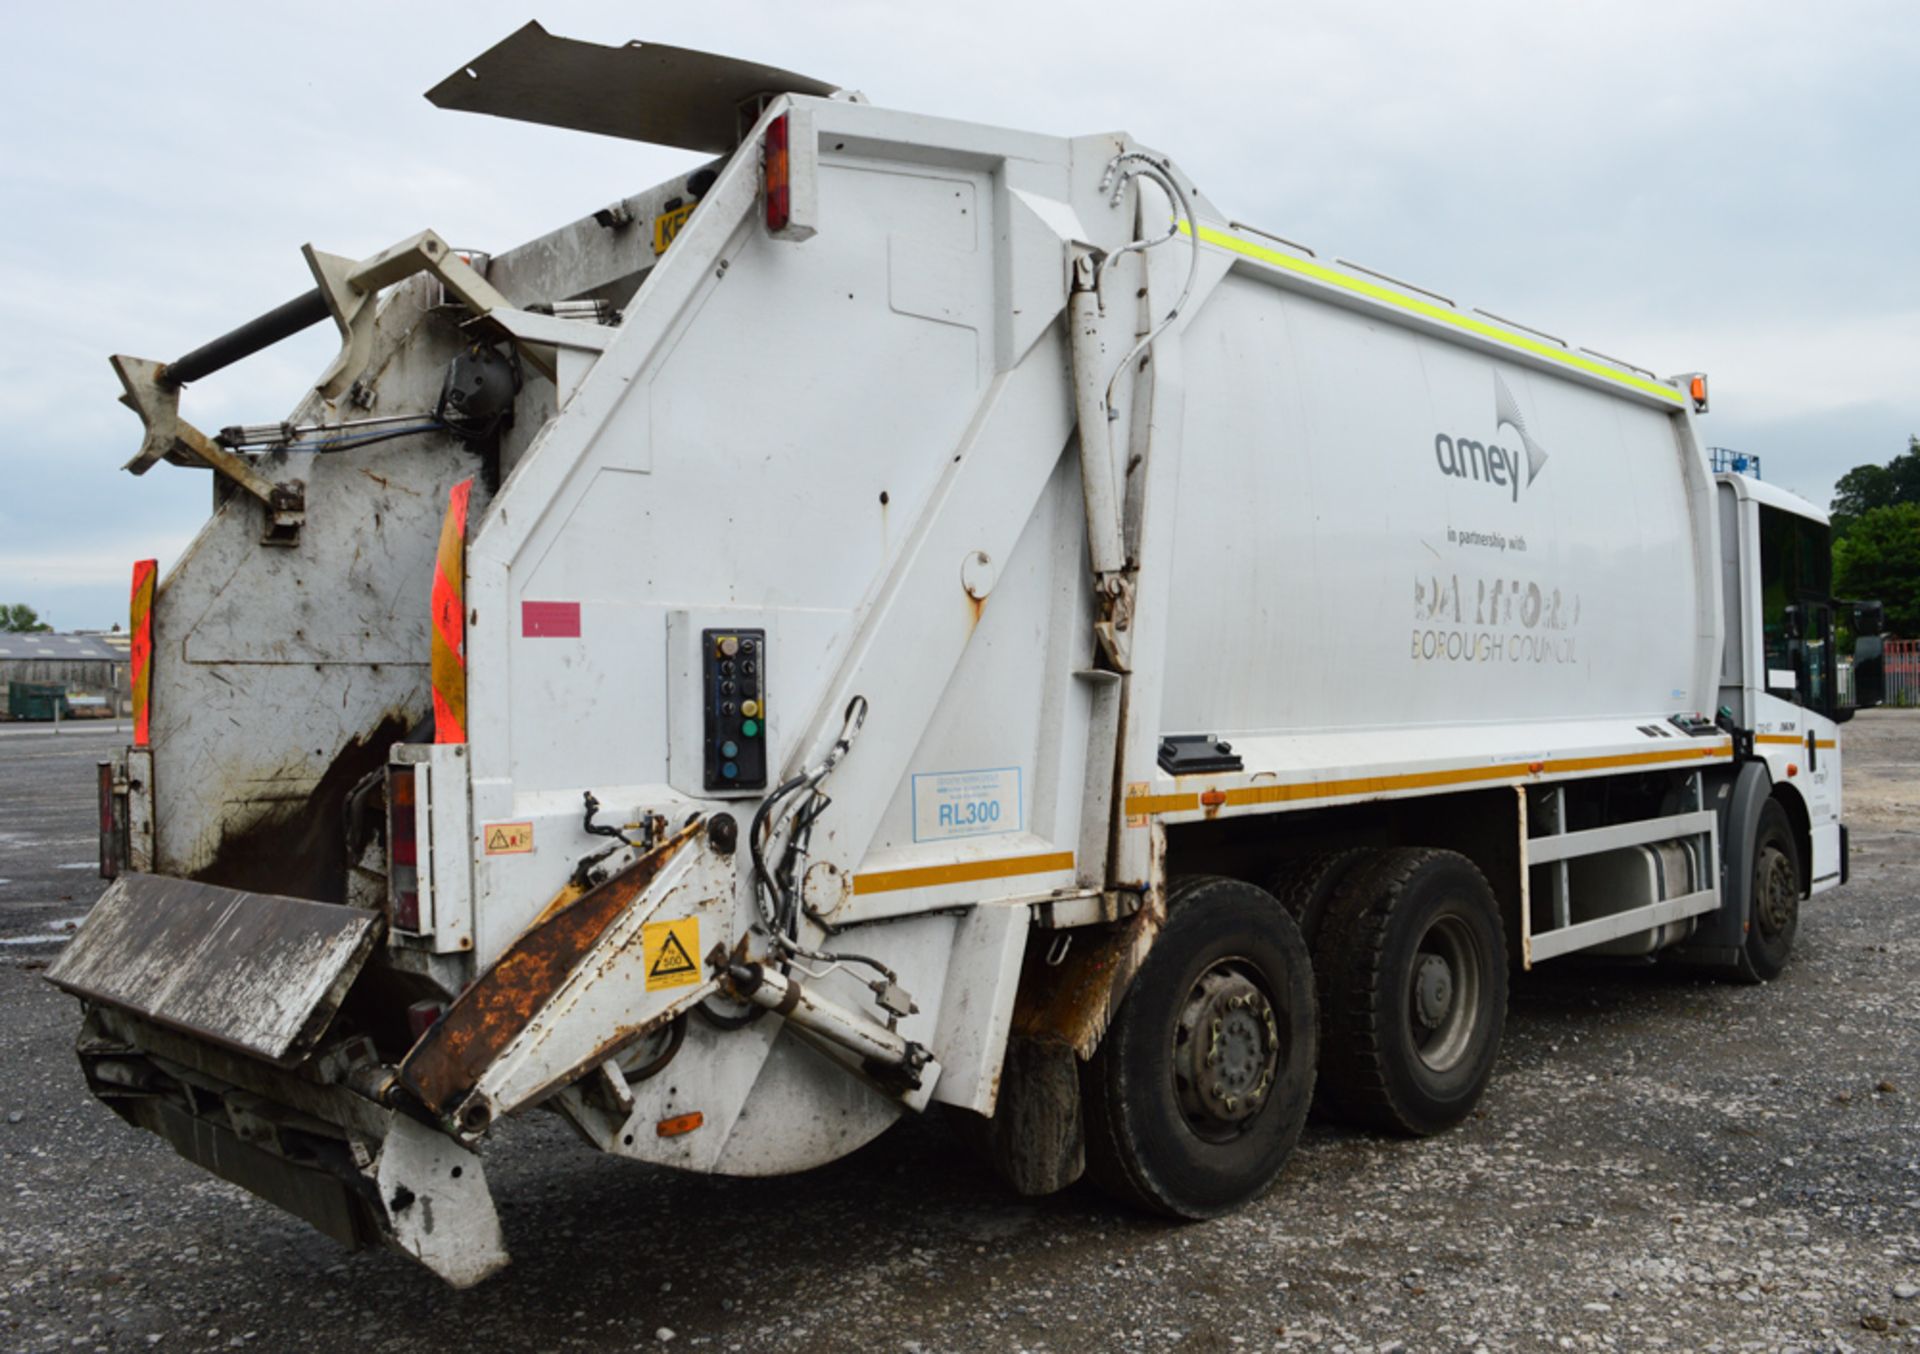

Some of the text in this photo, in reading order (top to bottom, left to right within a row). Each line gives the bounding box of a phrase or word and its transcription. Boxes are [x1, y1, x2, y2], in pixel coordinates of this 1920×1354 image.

[1434, 431, 1520, 503] amey
[1447, 525, 1527, 553] in partnership with
[1410, 630, 1577, 665] BOROUGH COUNCIL
[939, 800, 1000, 827] RL300
